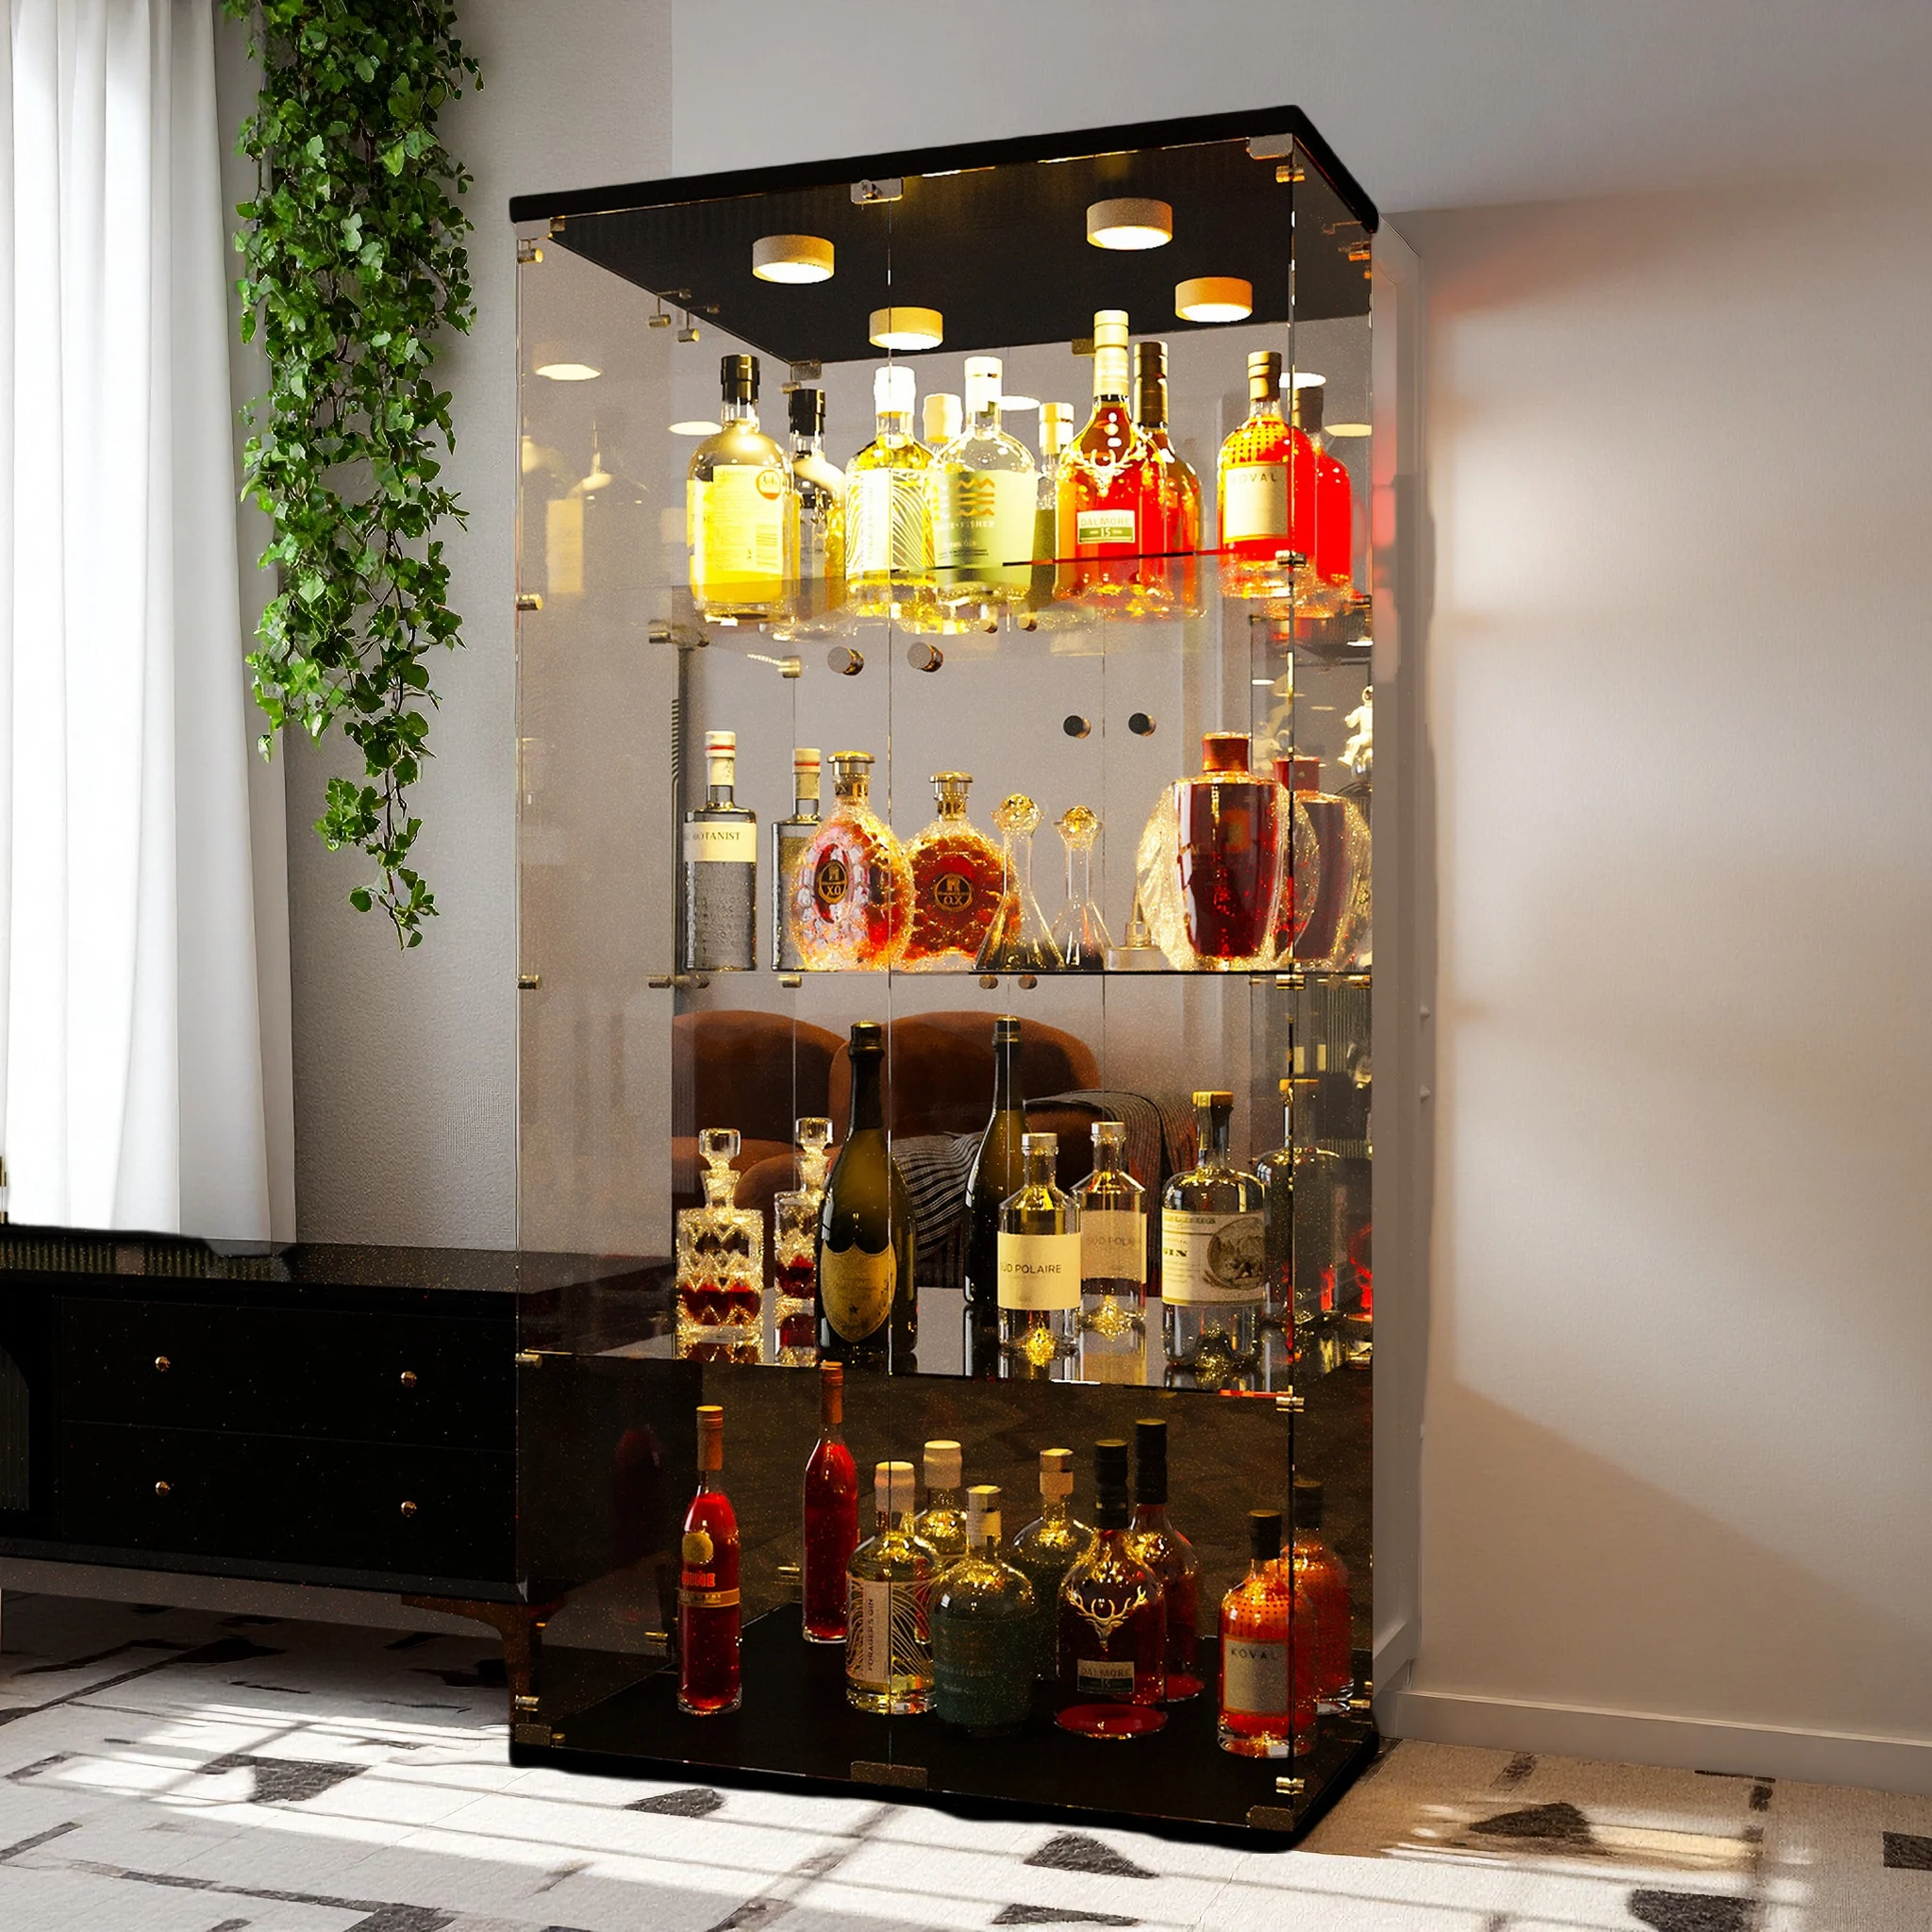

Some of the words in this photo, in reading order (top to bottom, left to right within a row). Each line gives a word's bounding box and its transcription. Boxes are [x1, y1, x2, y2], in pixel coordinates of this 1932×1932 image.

[1080, 517, 1131, 526] DALMORE
[1101, 527, 1111, 538] 15
[1015, 1264, 1061, 1274] POLAIRE
[1081, 1666, 1132, 1678] DALMORE
